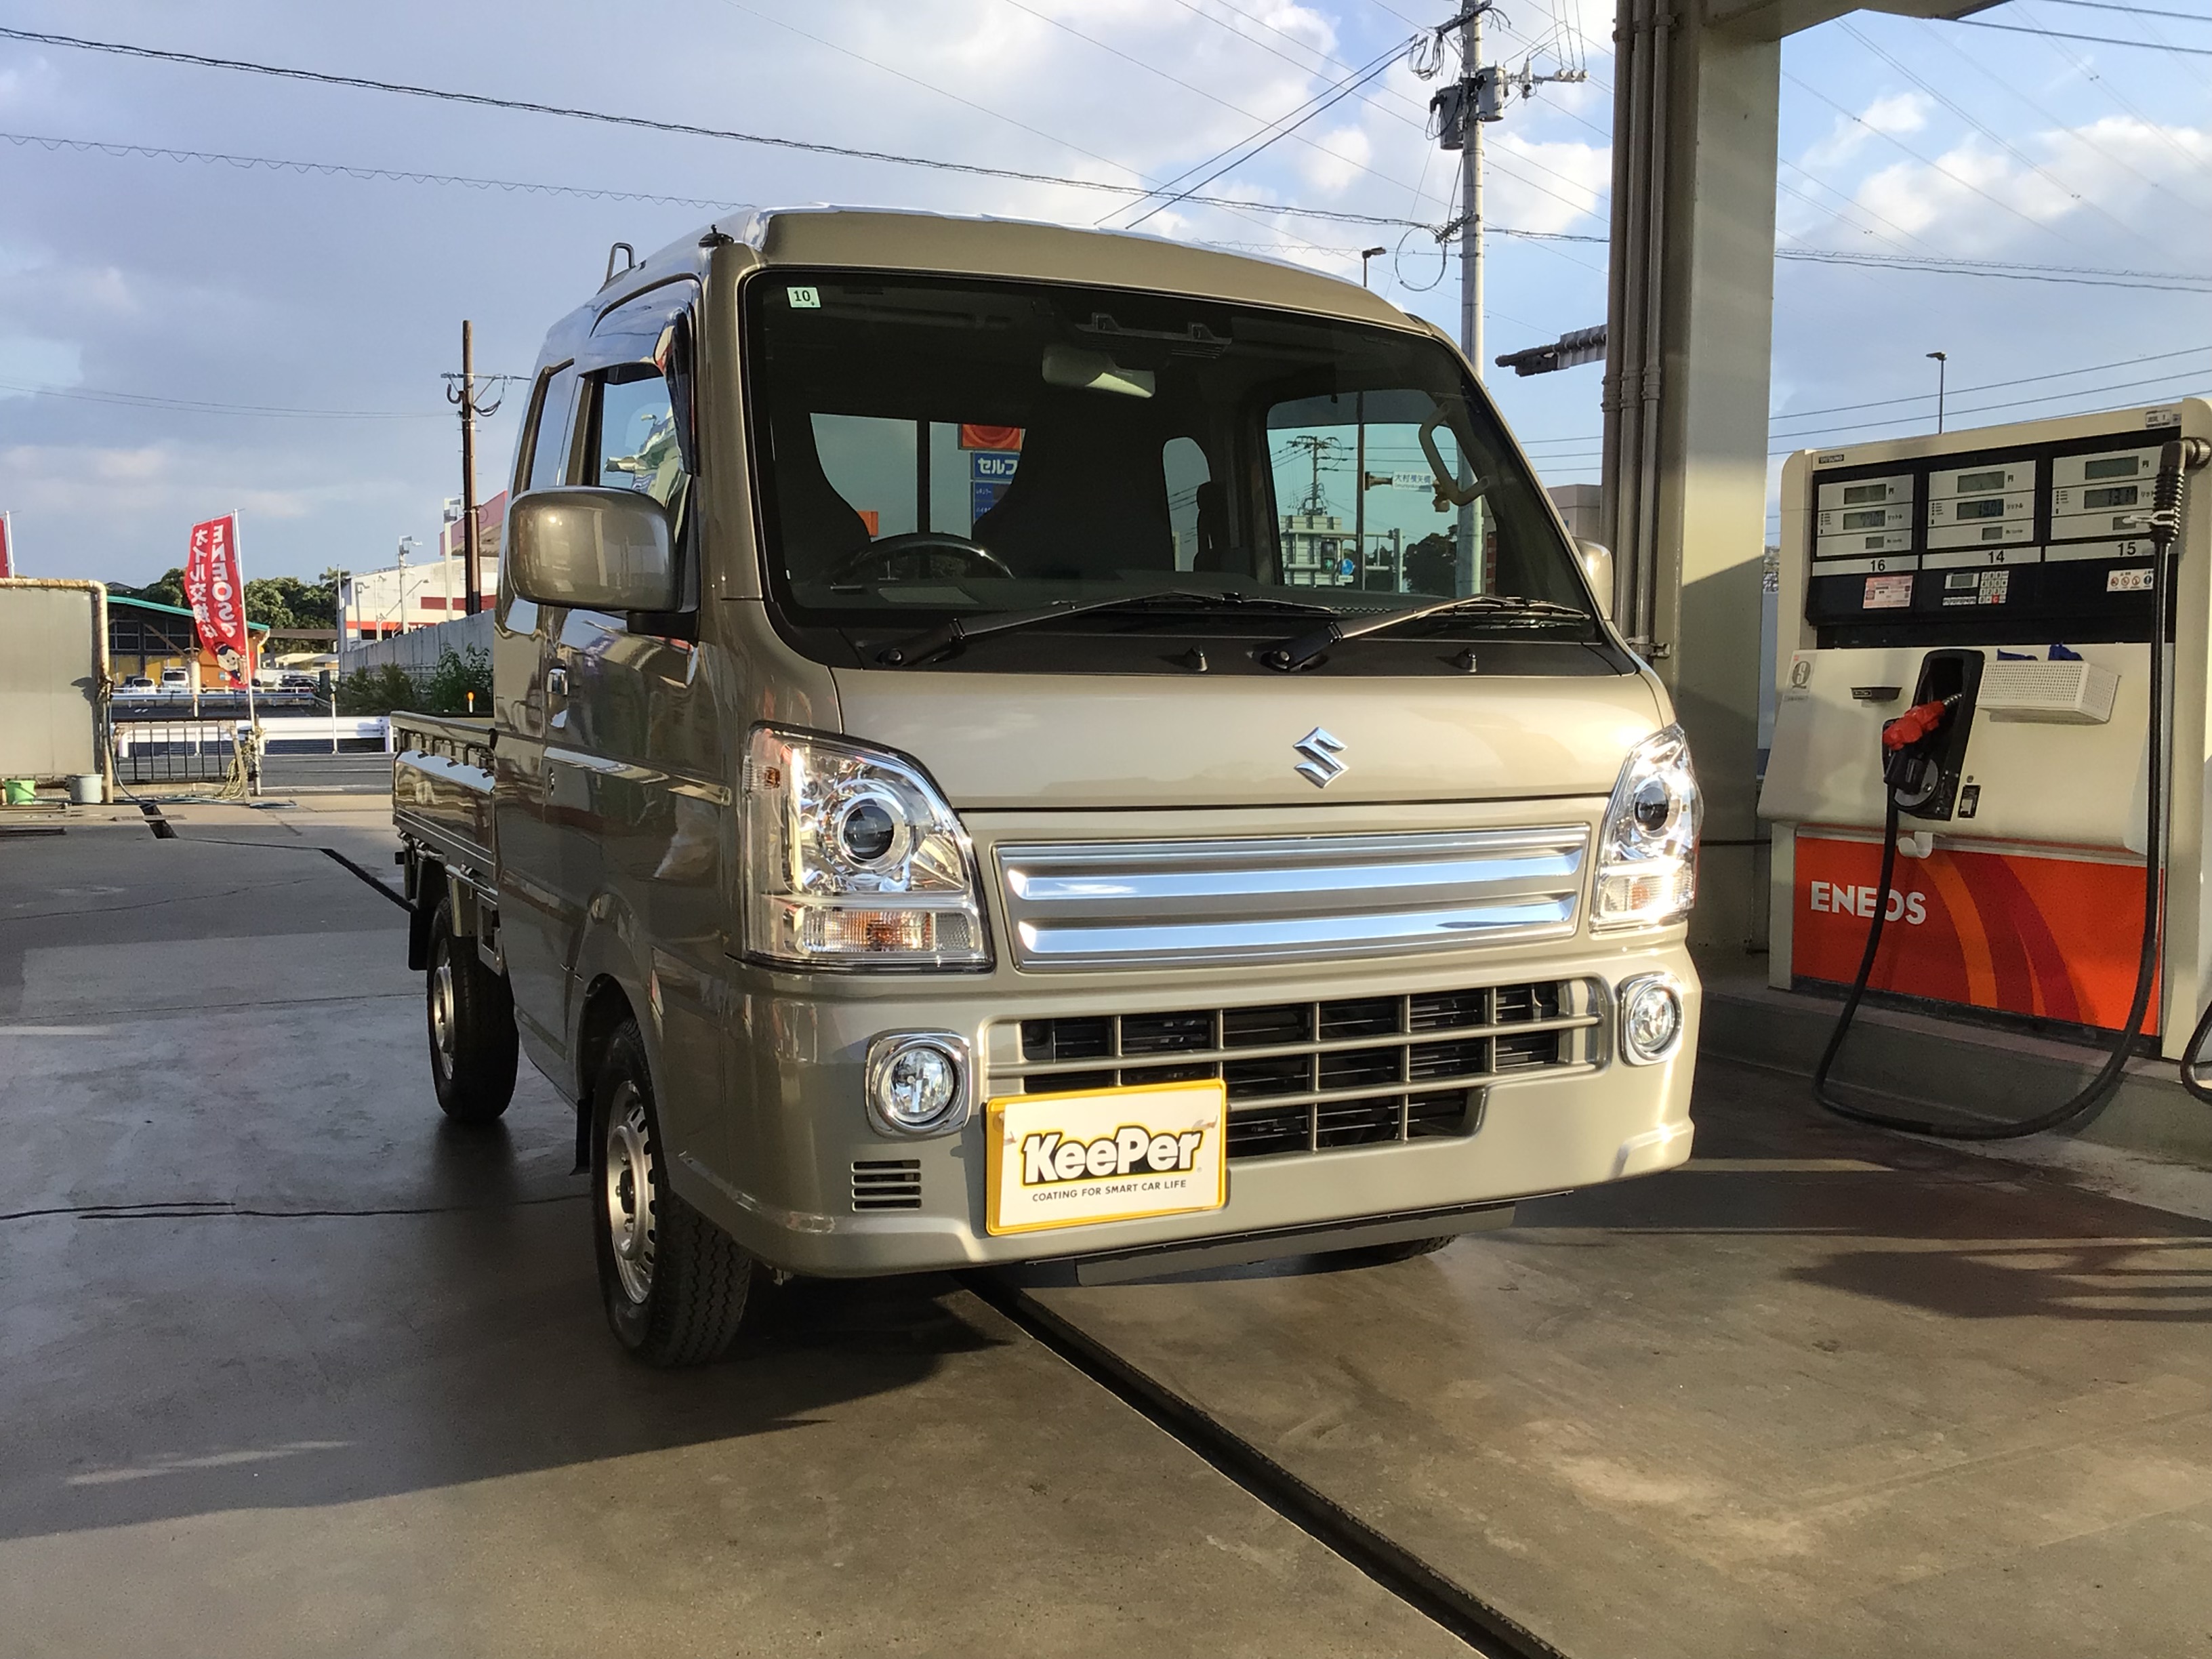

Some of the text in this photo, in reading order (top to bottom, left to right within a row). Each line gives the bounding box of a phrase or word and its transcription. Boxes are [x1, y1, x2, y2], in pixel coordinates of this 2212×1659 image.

[794, 290, 811, 302] 10
[978, 458, 1017, 475] セルフ
[2118, 542, 2137, 556] 15
[1988, 550, 2005, 564] 14
[1870, 559, 1886, 571] 16
[1811, 881, 1926, 925] ENEOS
[1021, 1126, 1203, 1185] KeePer
[1032, 1180, 1187, 1202] COATING FOR SMART CAR LIFE
